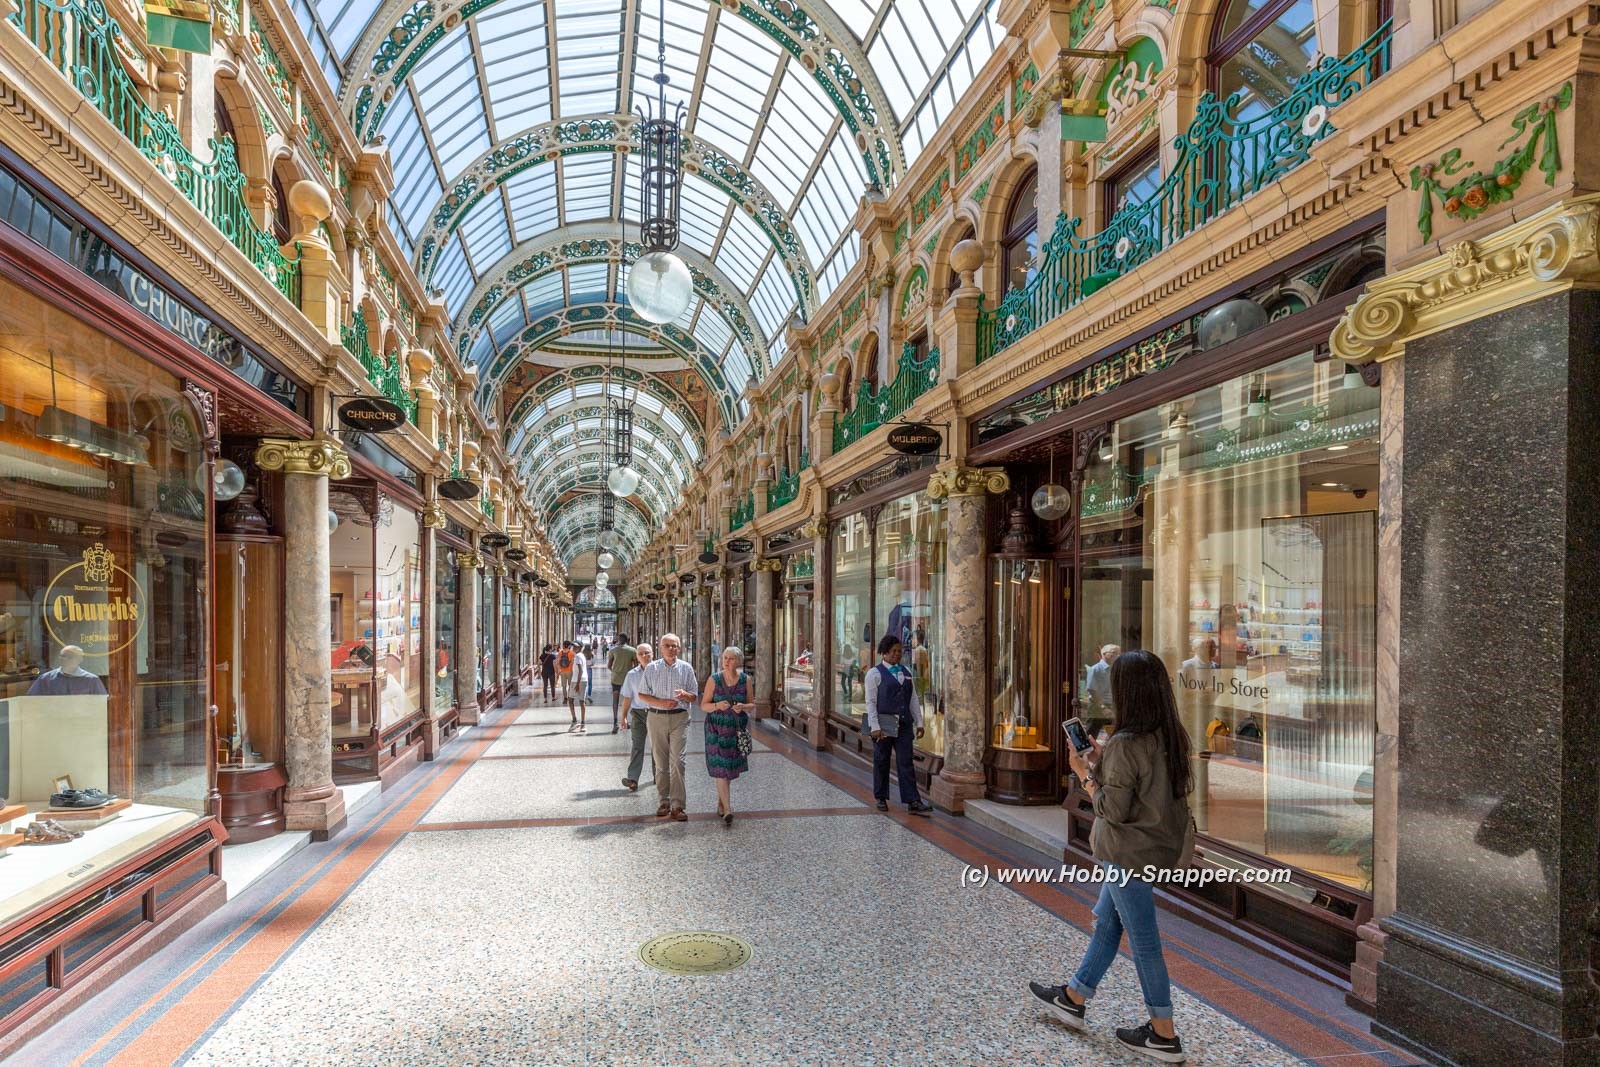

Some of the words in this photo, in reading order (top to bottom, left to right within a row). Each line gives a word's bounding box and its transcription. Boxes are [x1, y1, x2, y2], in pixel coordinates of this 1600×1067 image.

[1055, 331, 1175, 412] MULBERRY
[892, 434, 938, 444] MULBERRY
[53, 595, 139, 622] Church's
[1179, 671, 1207, 690] Now
[1212, 675, 1224, 693] In
[1230, 677, 1269, 699] Store
